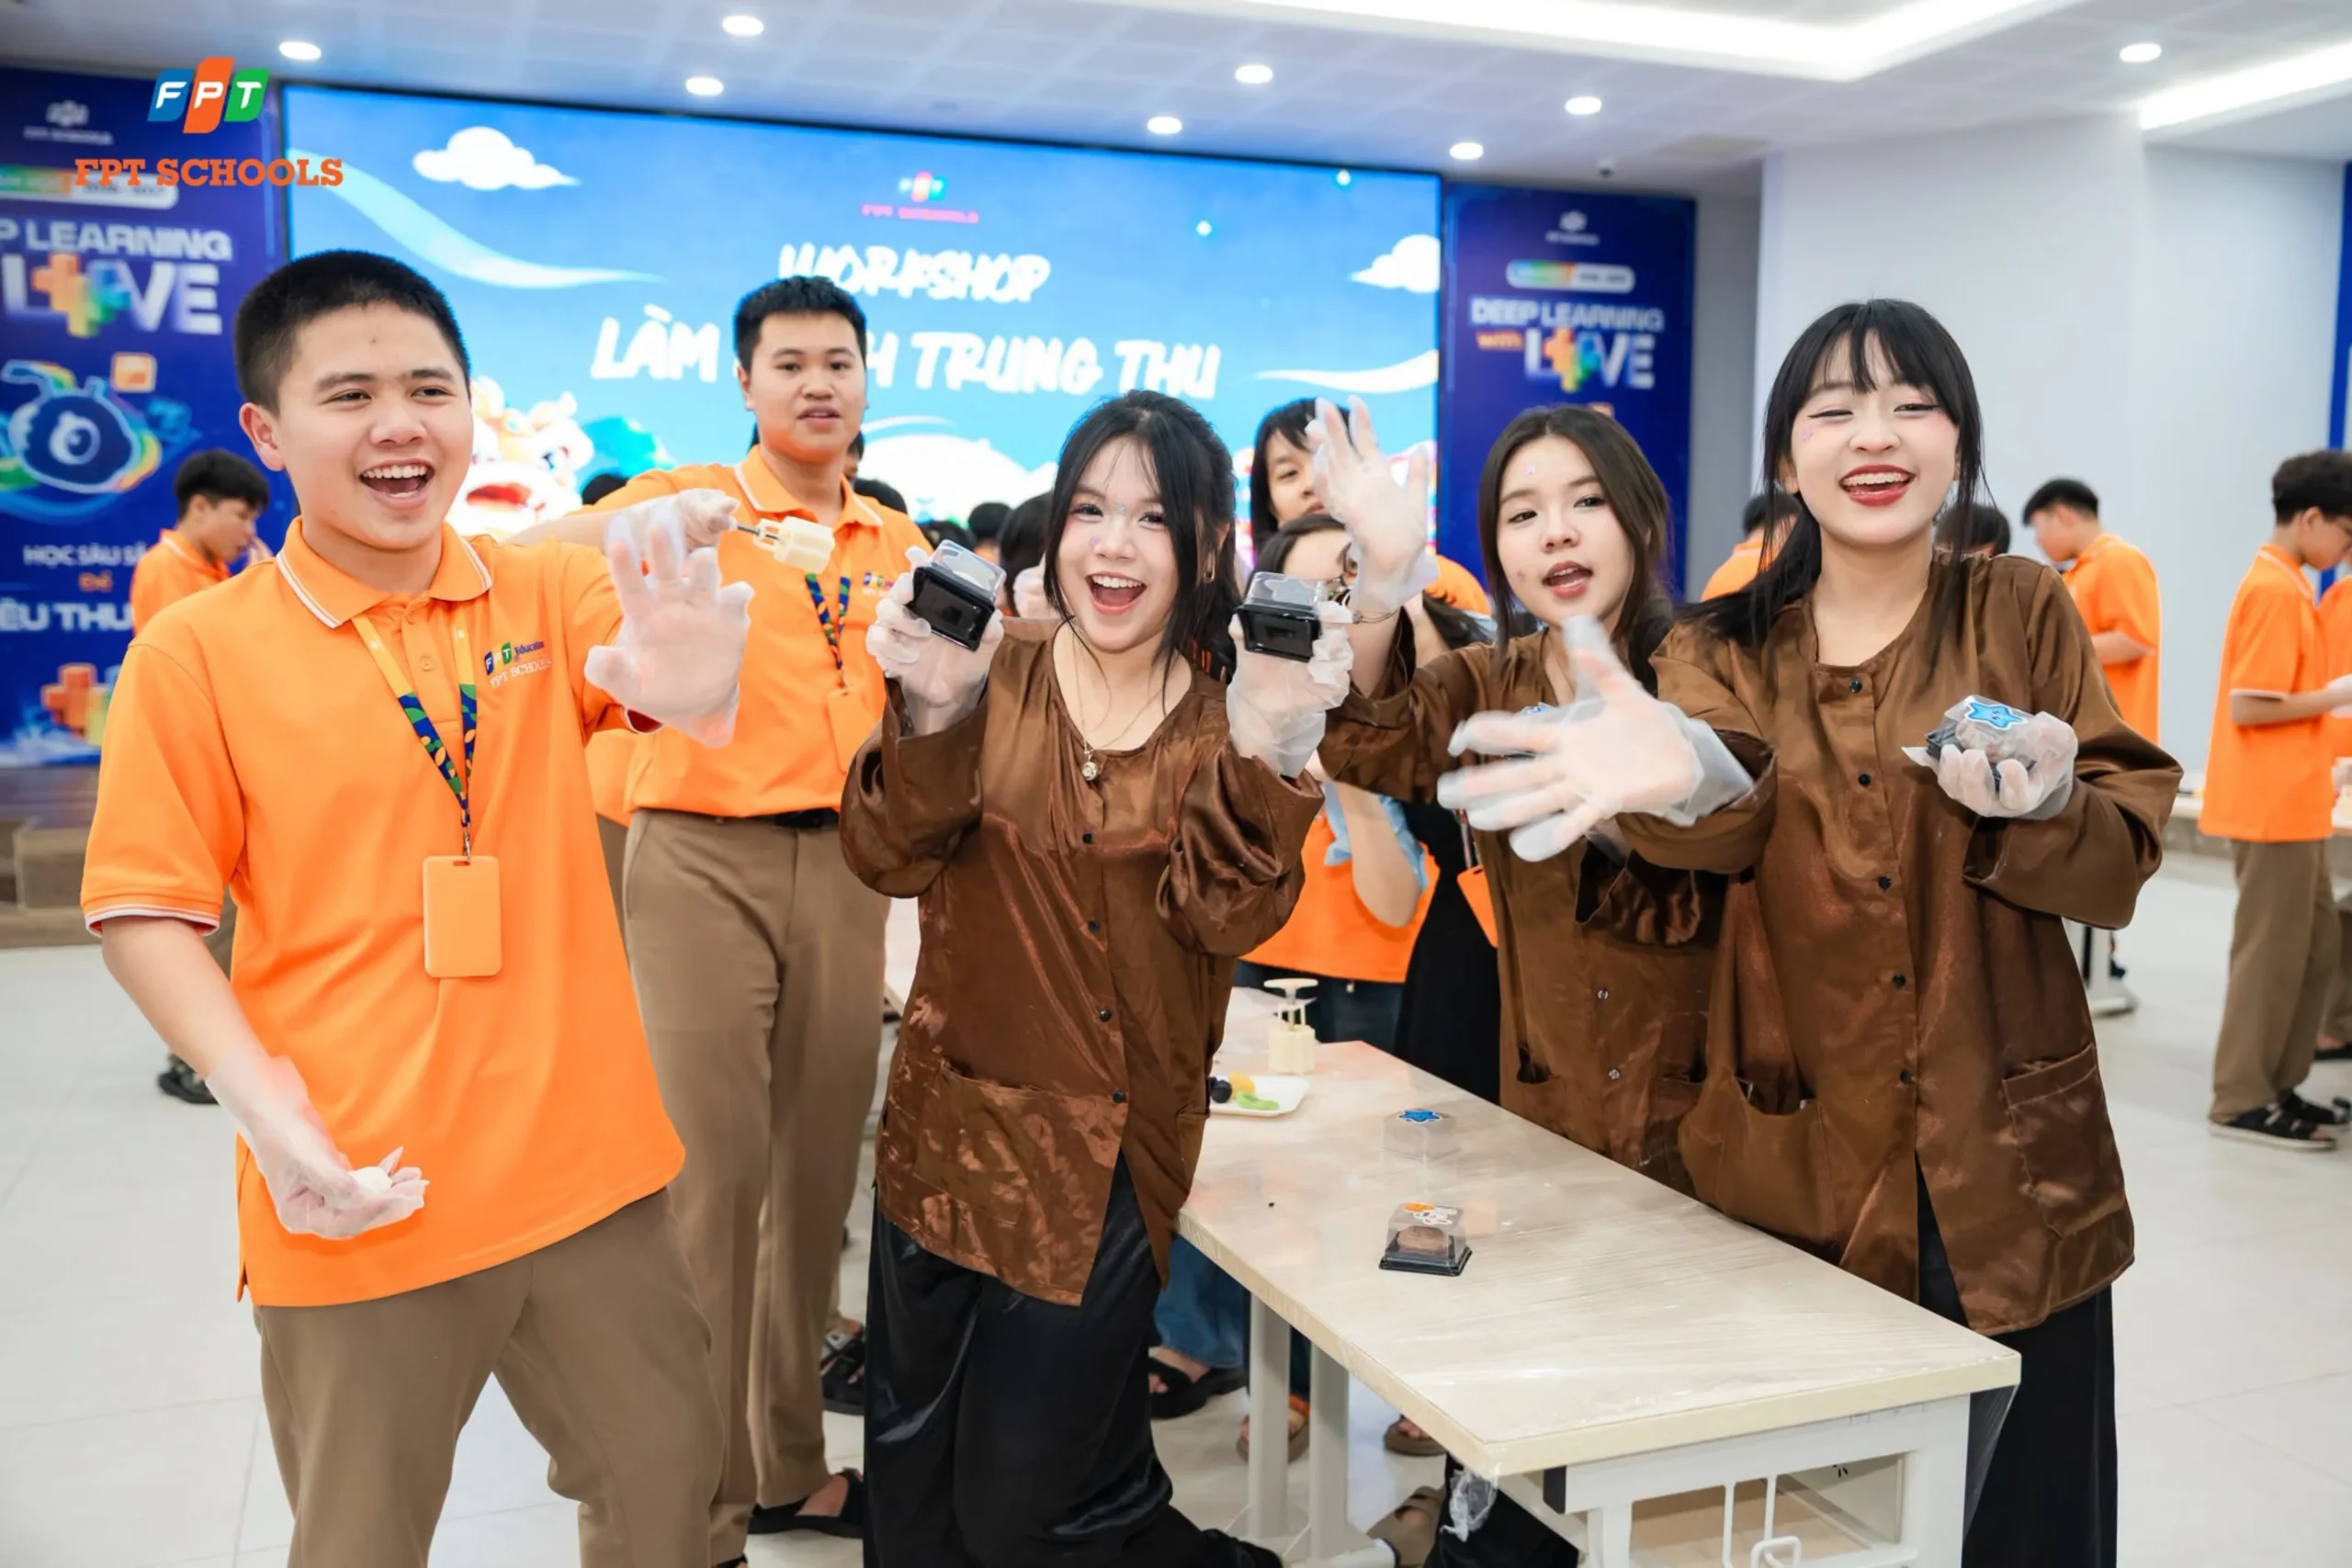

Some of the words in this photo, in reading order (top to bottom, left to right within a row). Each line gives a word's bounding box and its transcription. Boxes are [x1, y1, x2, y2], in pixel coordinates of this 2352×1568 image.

[26, 220, 232, 261] LEARNING
[778, 243, 1052, 303] WORKSHOP
[1471, 299, 1539, 325] DEEP
[590, 303, 720, 383] LÀM
[910, 332, 1103, 395] TRUNG
[1114, 340, 1221, 399] THU
[0, 597, 50, 631] ÊU
